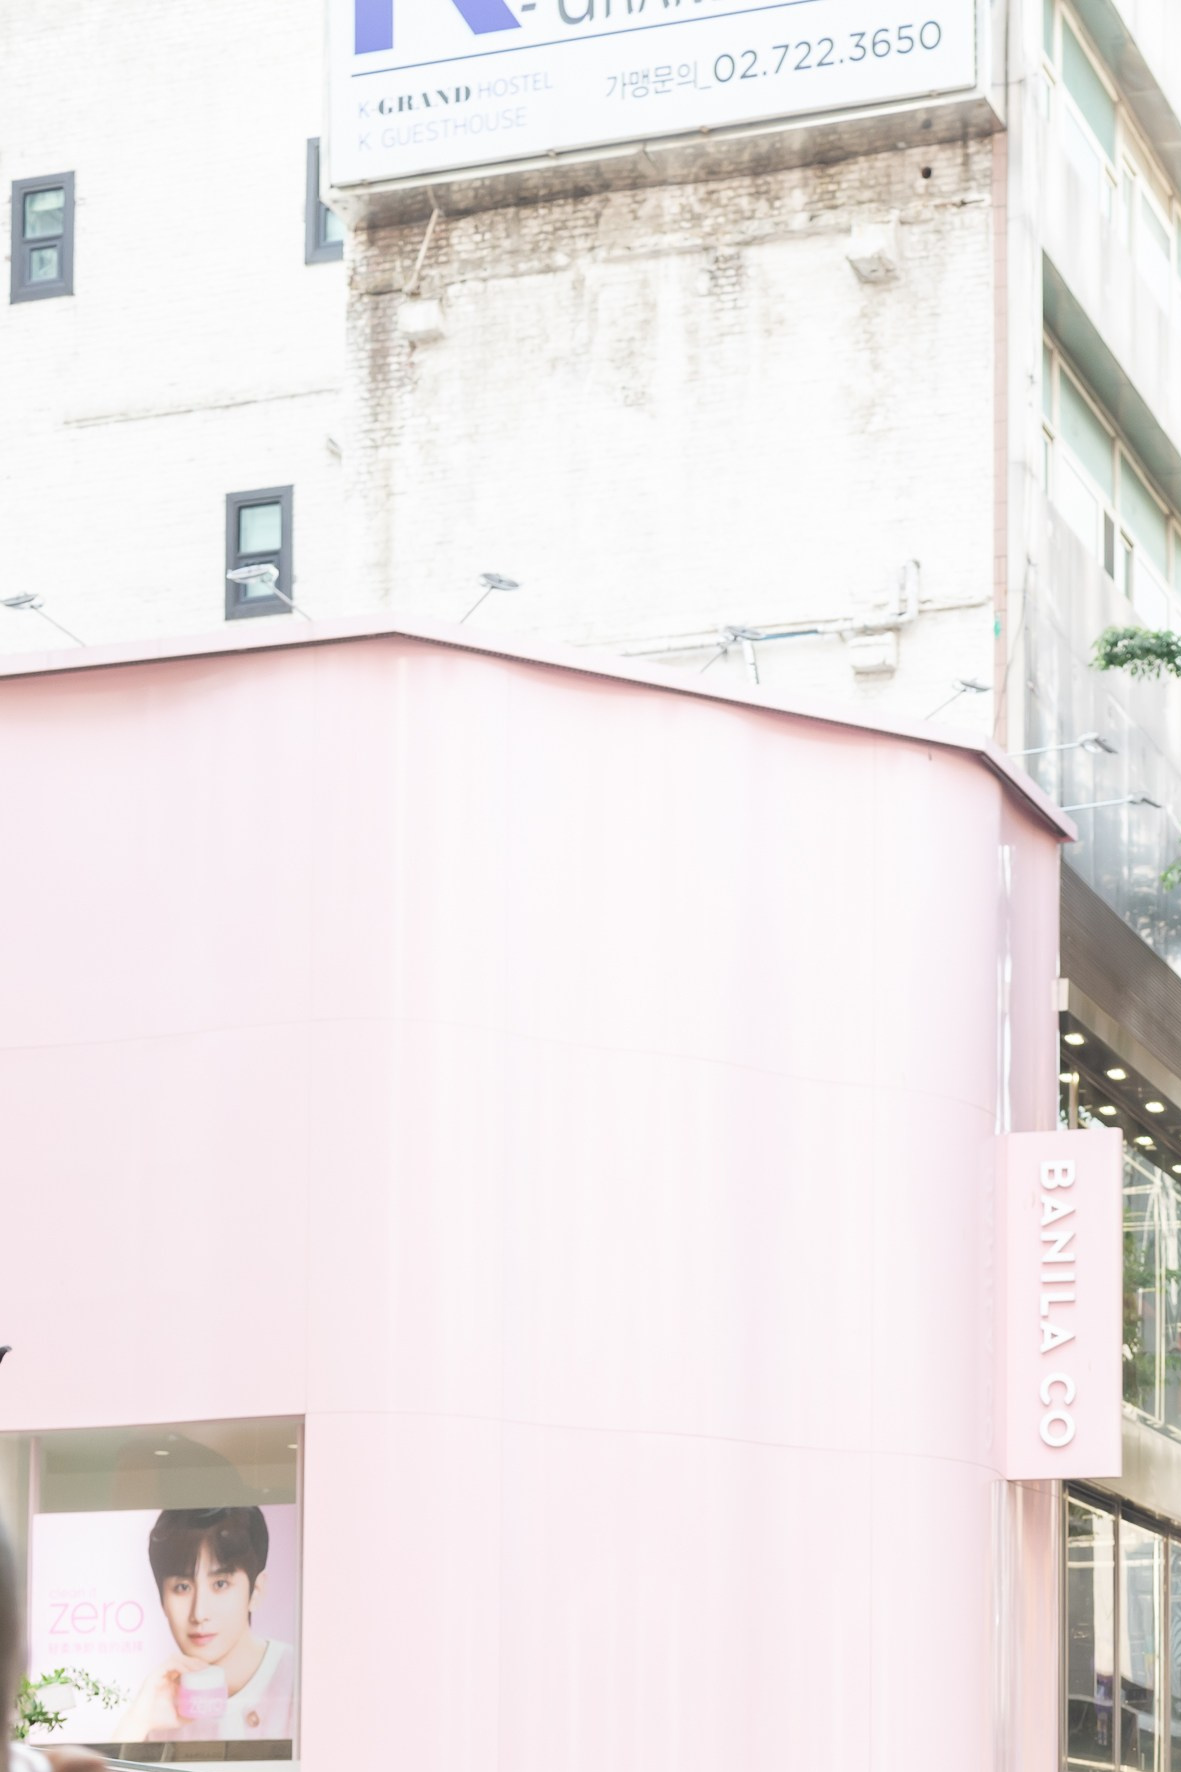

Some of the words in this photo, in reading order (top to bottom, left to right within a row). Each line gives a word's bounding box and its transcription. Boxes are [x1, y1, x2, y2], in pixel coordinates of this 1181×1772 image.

[477, 71, 553, 100] HOSTEL
[381, 107, 527, 148] GUESTHOUSE
[1039, 1159, 1077, 1353] BANILA
[1039, 1373, 1077, 1448] CO
[48, 1600, 144, 1634] zero
